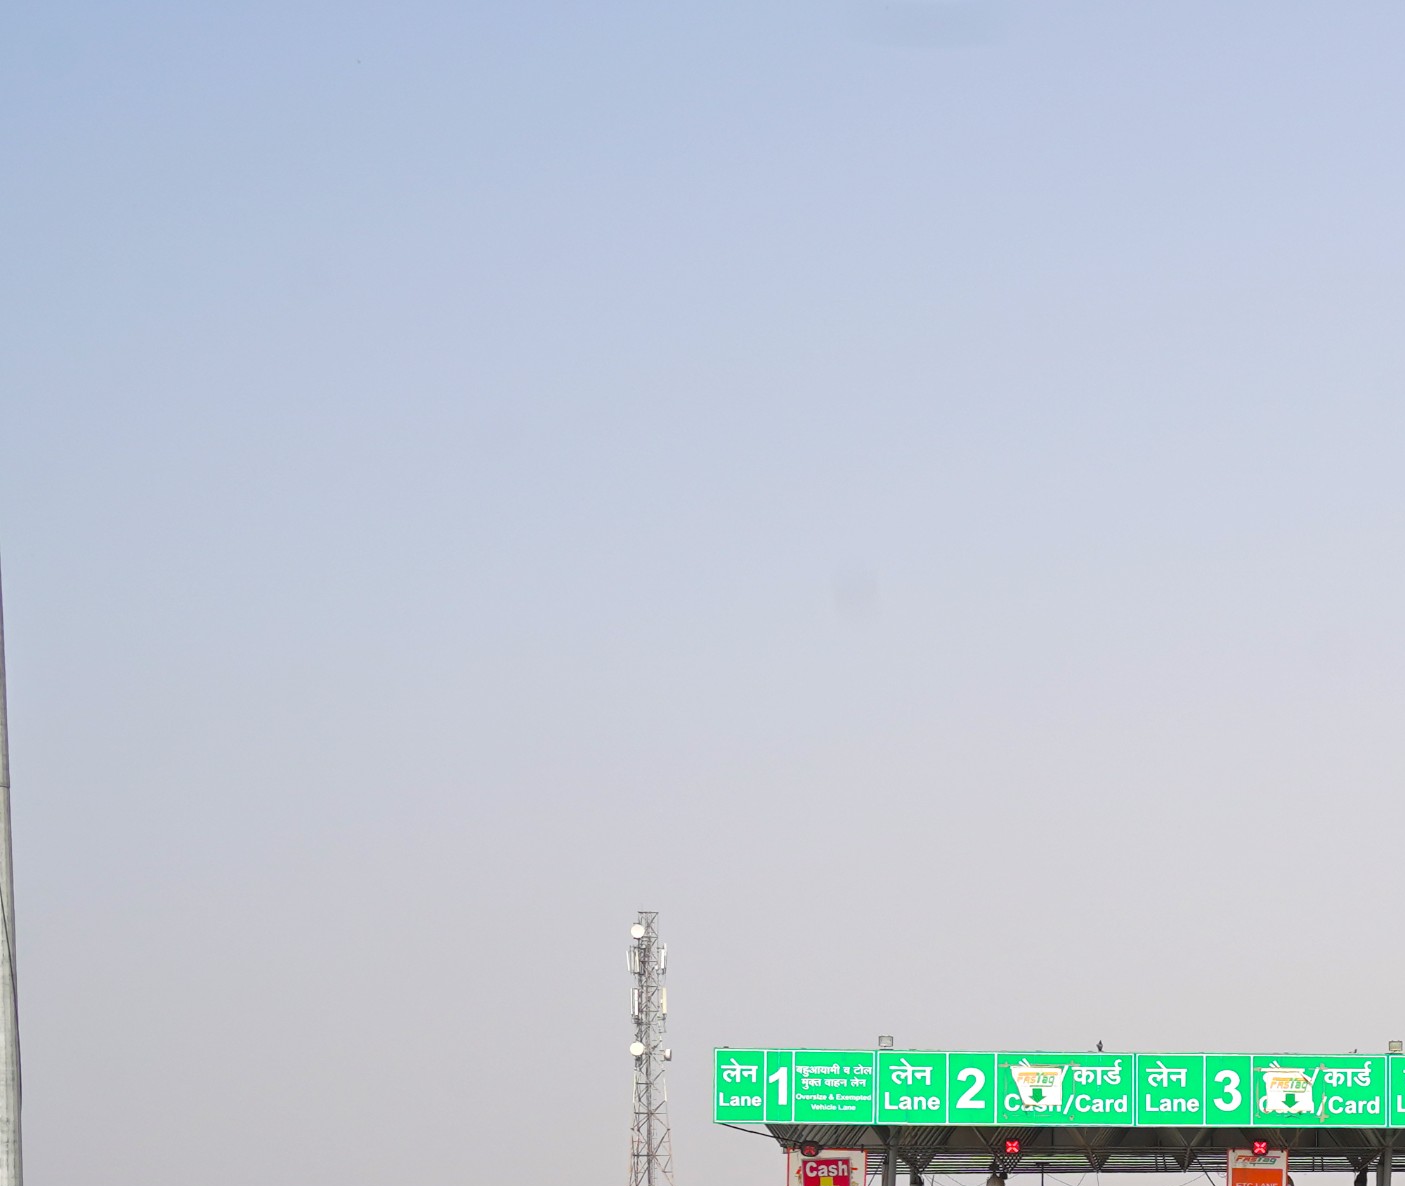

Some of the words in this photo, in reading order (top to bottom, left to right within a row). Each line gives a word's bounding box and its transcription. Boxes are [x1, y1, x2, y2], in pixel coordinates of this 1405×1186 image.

[721, 1058, 758, 1082] लेन
[853, 1064, 872, 1075] टोल
[889, 1058, 933, 1085] लेन
[1072, 1059, 1122, 1085] कार्ड
[1146, 1061, 1187, 1087] लेन
[1323, 1061, 1371, 1087] कार्ड
[769, 1067, 787, 1105] 1
[801, 1078, 821, 1089] मुक्त
[824, 1078, 847, 1087] वाहन
[851, 1077, 866, 1087] लेन
[956, 1068, 985, 1109] 2
[1214, 1070, 1242, 1111] 3
[719, 1092, 762, 1106] Lane
[884, 1092, 940, 1110] Lane
[1146, 1094, 1199, 1112] Lane
[806, 1160, 847, 1177] Cash
